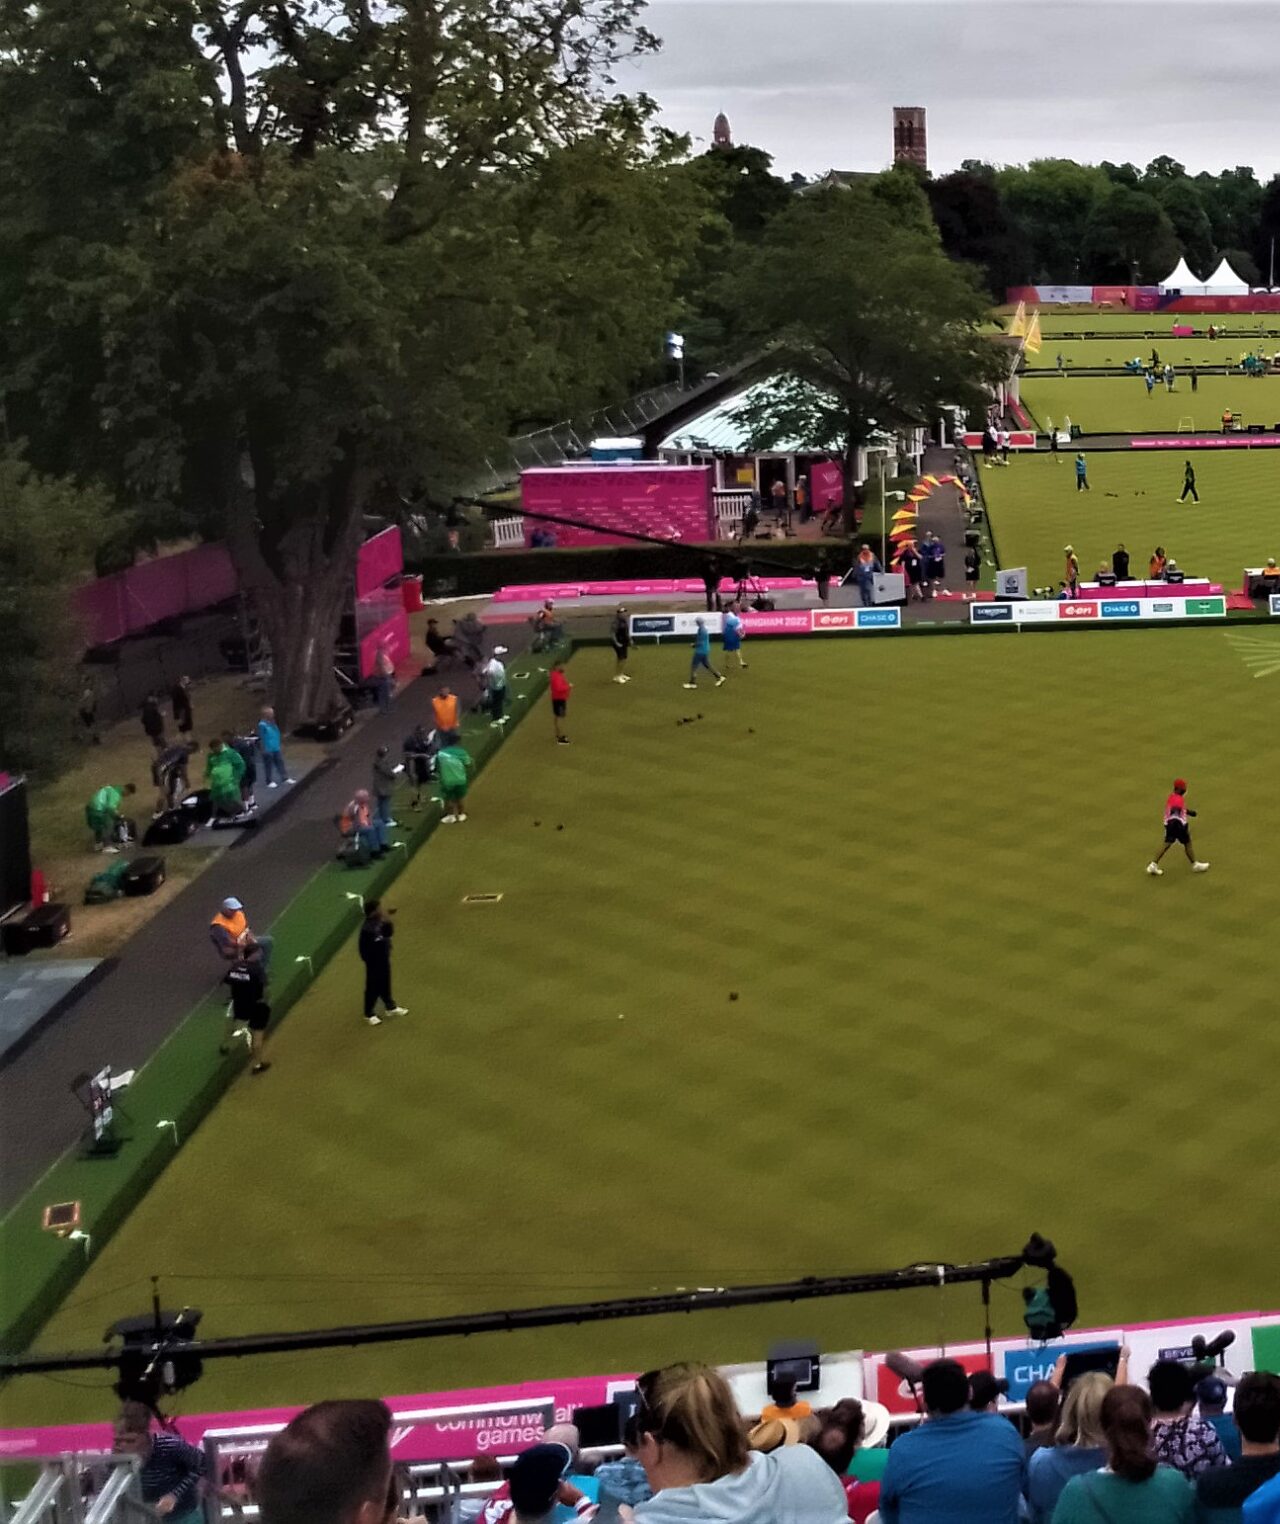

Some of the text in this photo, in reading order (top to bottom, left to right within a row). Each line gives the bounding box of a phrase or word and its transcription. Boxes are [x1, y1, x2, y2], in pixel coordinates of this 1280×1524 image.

[740, 616, 808, 627] MINGHAM 2022
[1014, 1362, 1055, 1384] CHA
[435, 1402, 584, 1431] commonwal
[476, 1424, 545, 1451] games
